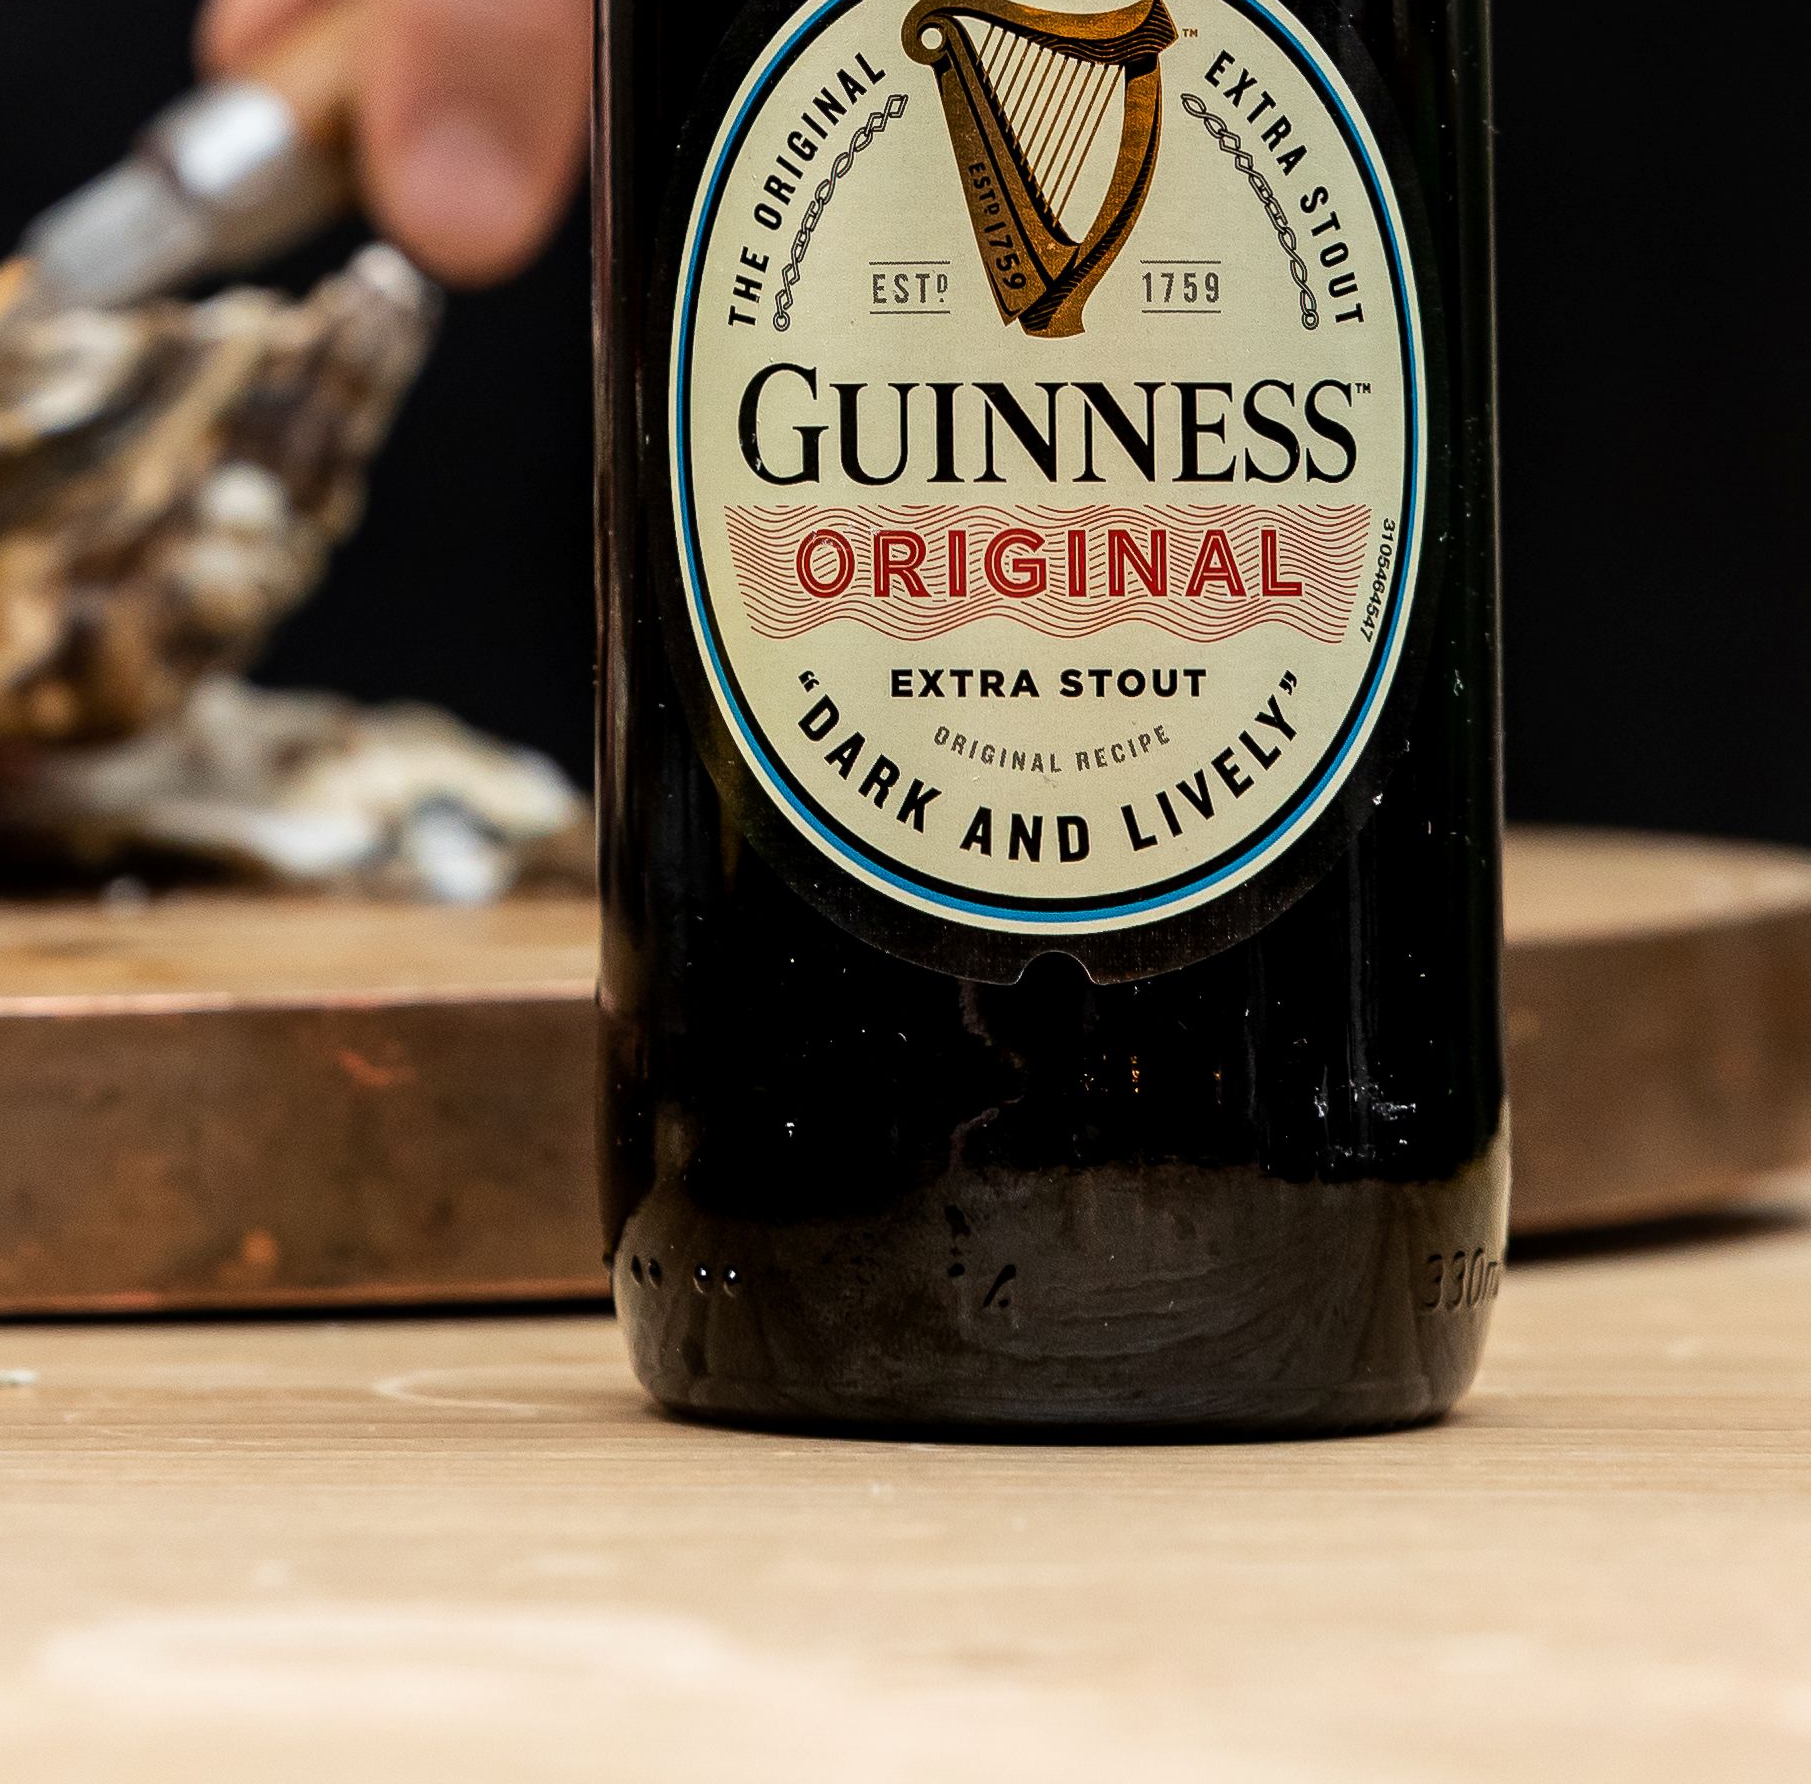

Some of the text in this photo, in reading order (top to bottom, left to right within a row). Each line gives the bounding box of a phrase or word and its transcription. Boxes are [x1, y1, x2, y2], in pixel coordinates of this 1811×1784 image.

[728, 52, 886, 326] THE ORIGINAL
[1204, 49, 1365, 323] EXTRA STOUT
[984, 221, 1027, 289] 1759
[1142, 272, 1220, 303] 1759
[737, 362, 1358, 486] GUINNESS
[795, 528, 1303, 598] ORIGINAL
[1360, 517, 1396, 642] 3105464547
[891, 669, 1207, 698] EXTRA STOUT
[933, 724, 1171, 773] ORIGINAL RECIPE
[959, 806, 1090, 863] AND
